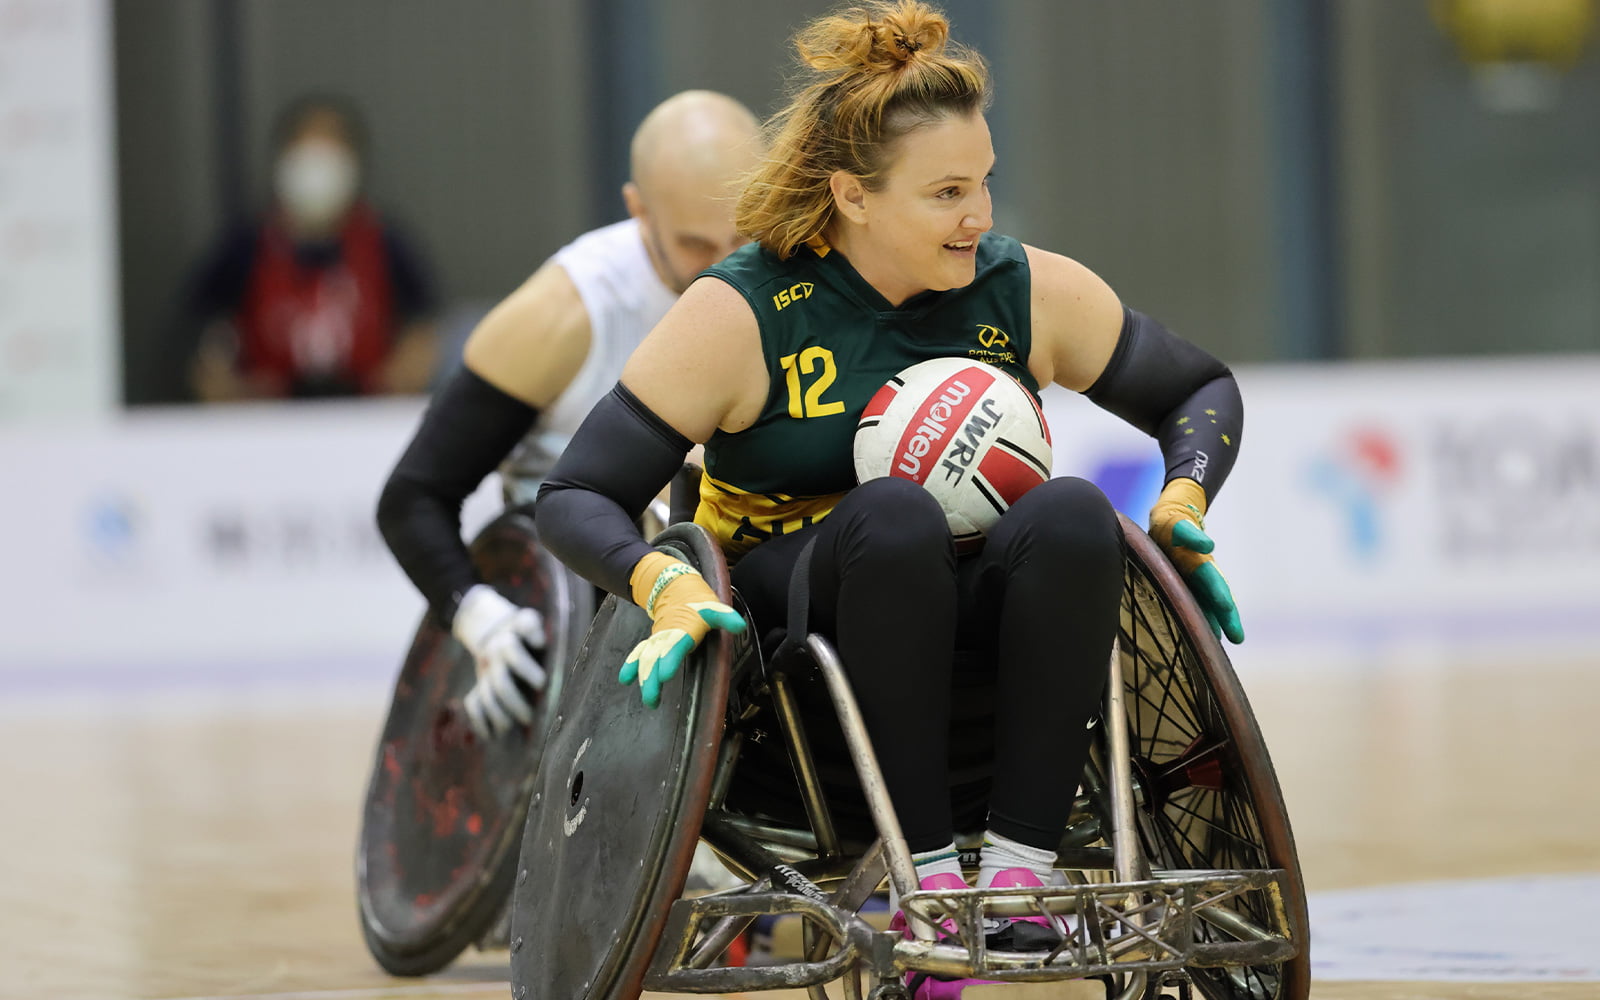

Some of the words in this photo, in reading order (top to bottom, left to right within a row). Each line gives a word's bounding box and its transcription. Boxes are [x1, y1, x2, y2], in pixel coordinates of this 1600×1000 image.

[780, 346, 845, 418] 12
[898, 380, 971, 475] molten
[941, 398, 1003, 488] JWRF
[1191, 449, 1209, 483] 2XU
